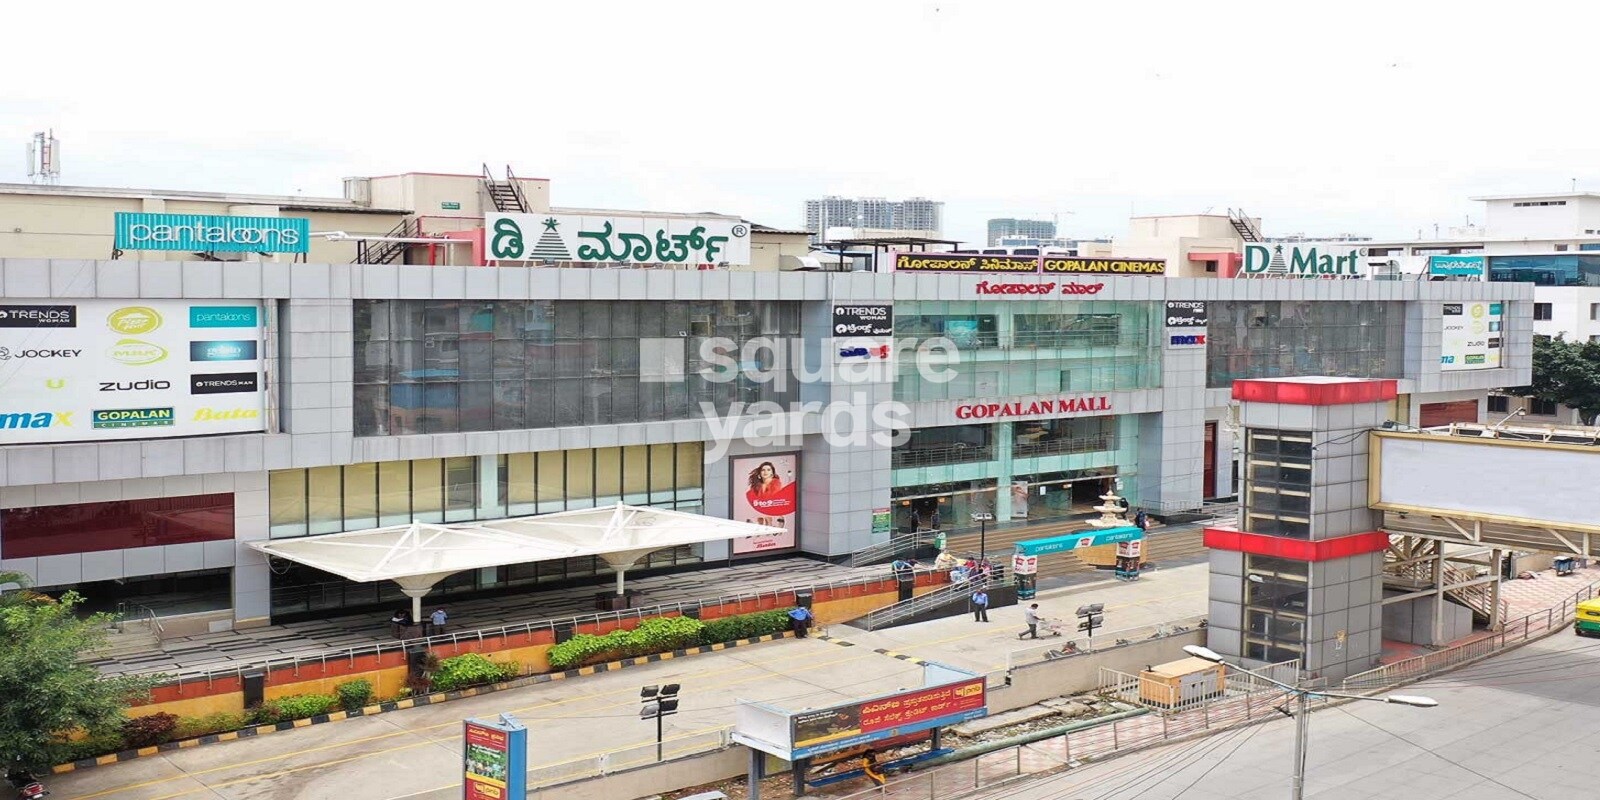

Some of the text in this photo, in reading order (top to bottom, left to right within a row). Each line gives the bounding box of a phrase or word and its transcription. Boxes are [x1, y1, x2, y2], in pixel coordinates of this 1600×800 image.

[130, 221, 299, 245] pantaloons
[897, 256, 1039, 271] ಗೋಪಾಲನ್ ಸಿನಿಮಾಸ್
[1044, 260, 1165, 273] GOPALAN CINEMAS
[976, 280, 1105, 295] ಗೋಪಾಲನ್ ಮಾಲ್
[8, 310, 70, 319] TRENDS
[845, 307, 887, 315] TRENDS
[196, 312, 251, 324] pantaloons
[15, 349, 82, 358] JOCKEY
[99, 379, 171, 392] zudio
[204, 379, 238, 387] TRENDS
[193, 407, 258, 421] Bata
[955, 396, 1112, 420] GOPALAN MALL
[97, 409, 171, 421] GOPALAN
[101, 420, 169, 428] CINEMAS
